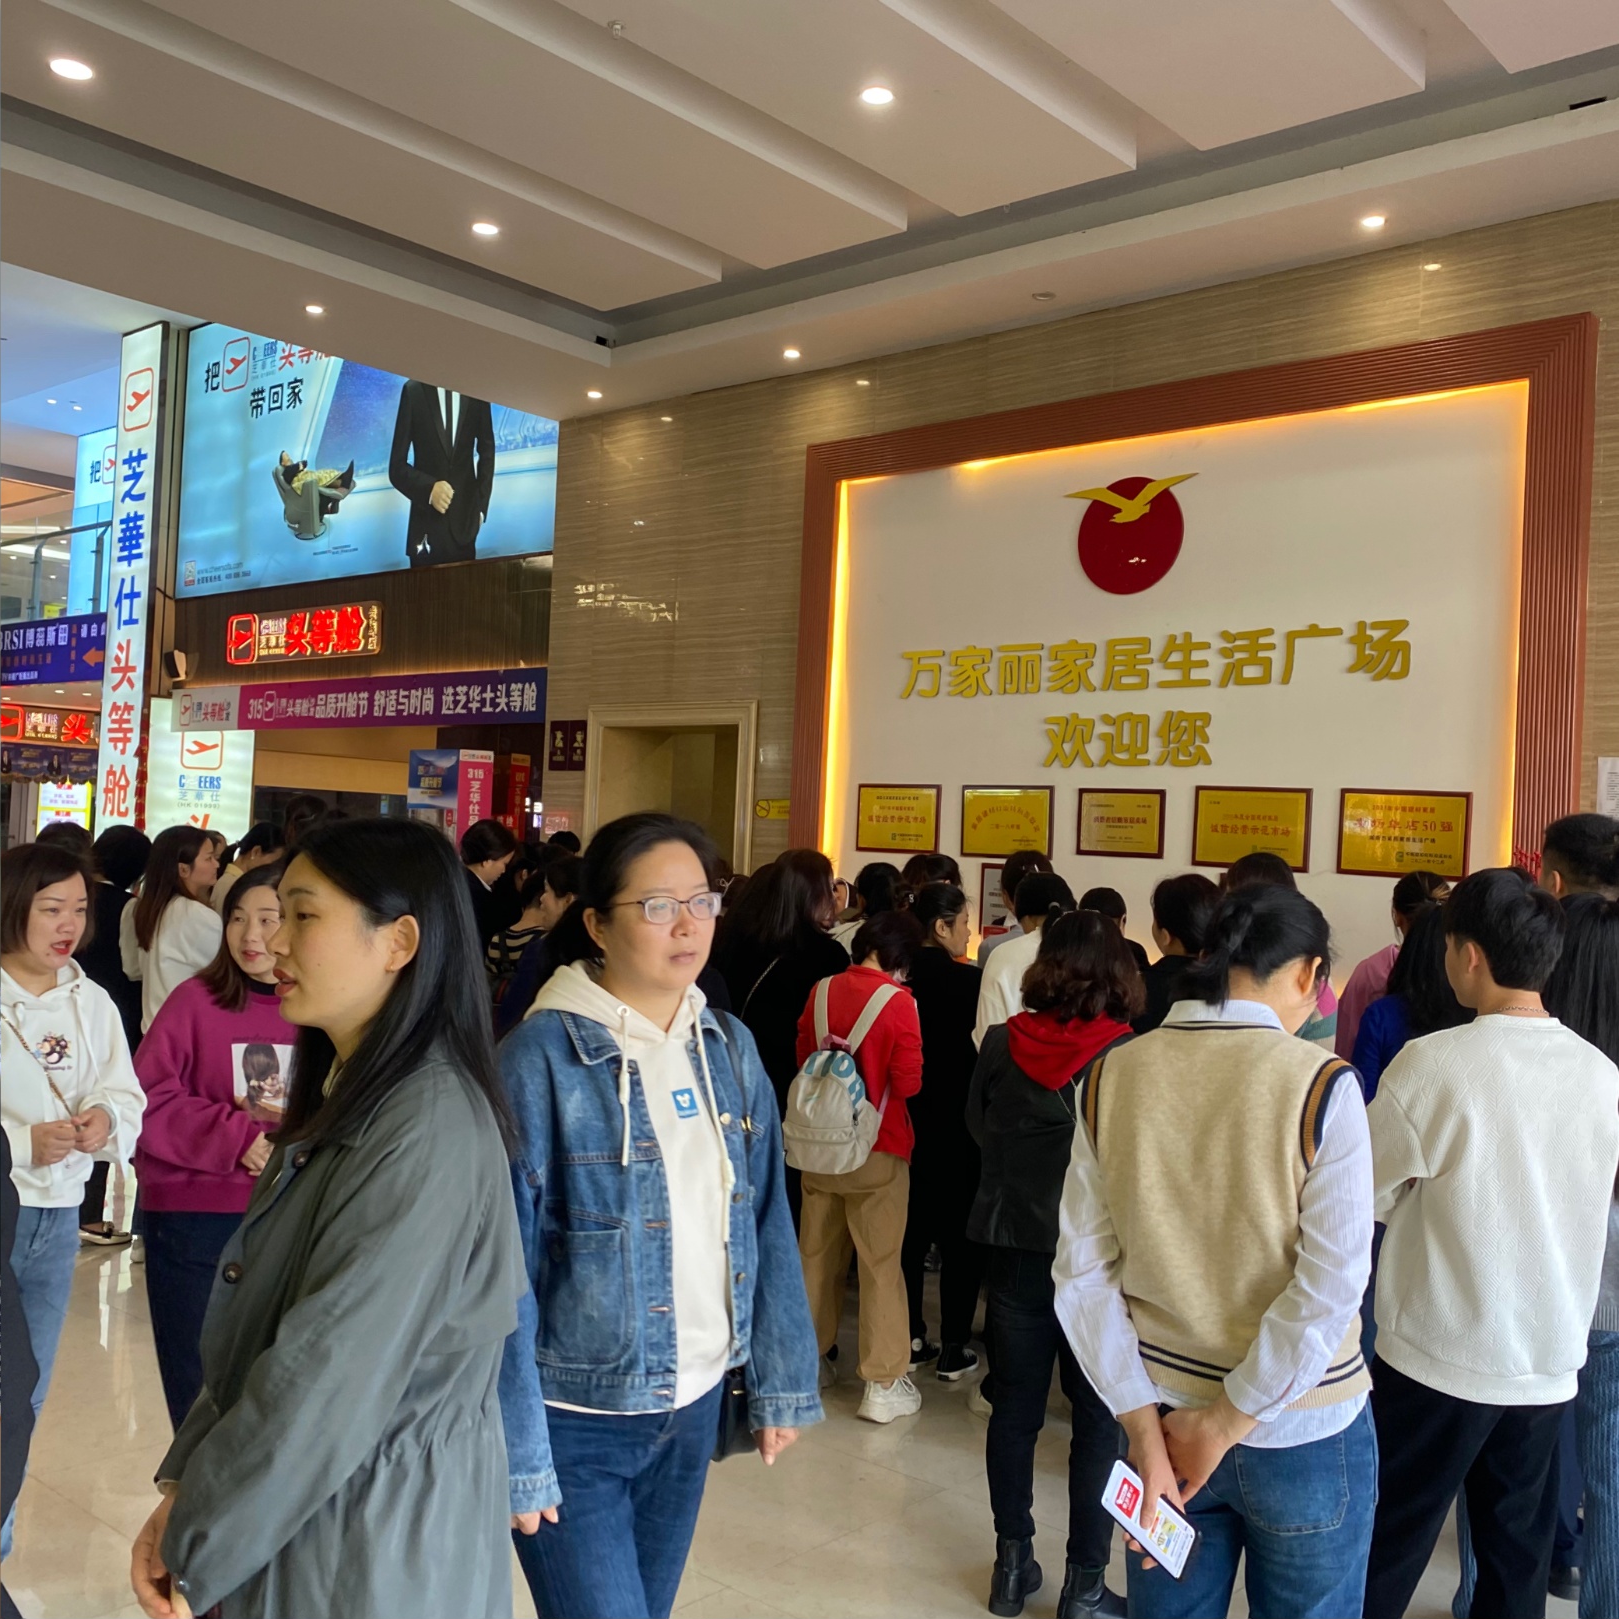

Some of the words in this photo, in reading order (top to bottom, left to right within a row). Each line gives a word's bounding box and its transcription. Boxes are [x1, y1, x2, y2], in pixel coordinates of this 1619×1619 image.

[204, 361, 221, 394] 把
[249, 376, 305, 419] 带回家
[102, 448, 149, 820] 芝華仕头等舱
[899, 617, 1414, 701] 万家丽家居生活广场
[247, 698, 263, 720] 315
[314, 691, 369, 719] 品质升舱节
[373, 686, 435, 718] 舒适与时尚
[441, 681, 538, 715] 选芝华士头等舱
[1042, 709, 1216, 770] 欢迎您
[467, 768, 485, 780] 315
